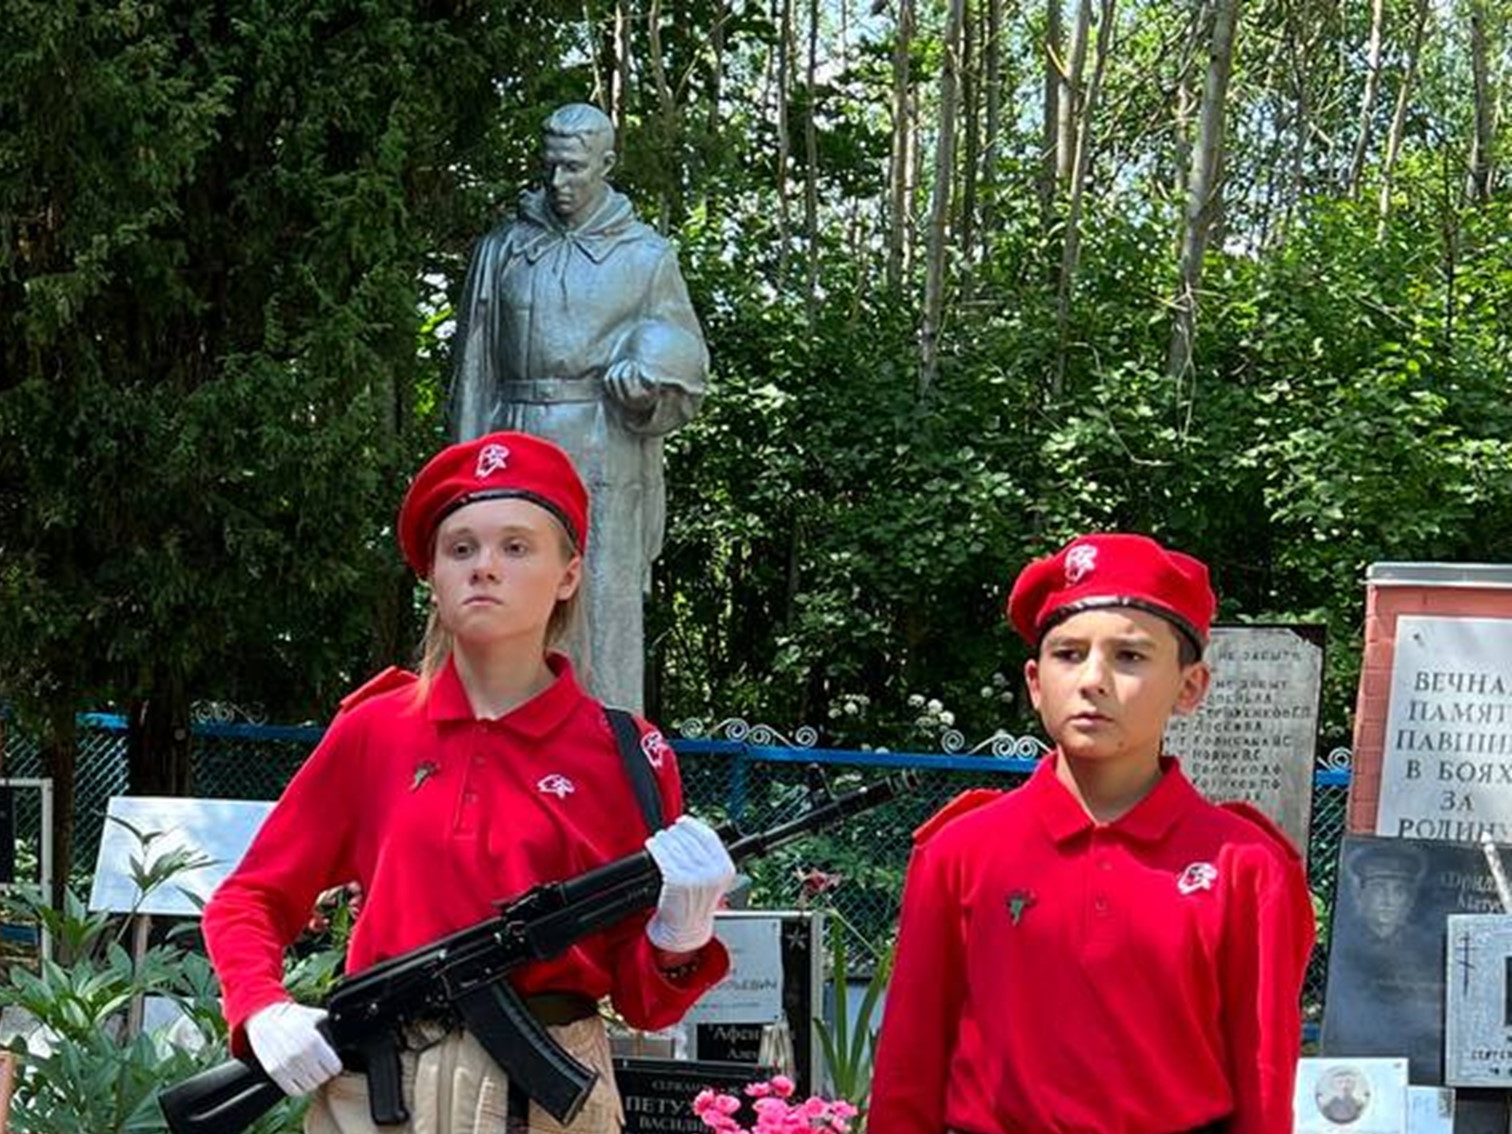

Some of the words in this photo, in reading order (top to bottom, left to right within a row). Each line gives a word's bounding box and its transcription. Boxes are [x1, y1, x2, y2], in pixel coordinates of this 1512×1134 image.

[1414, 671, 1512, 694] ВЕЧНА
[1395, 729, 1512, 754] ПАВШИ
[1406, 759, 1422, 780] В
[1438, 761, 1512, 783] БОЯХ
[1439, 791, 1475, 811] ЗА
